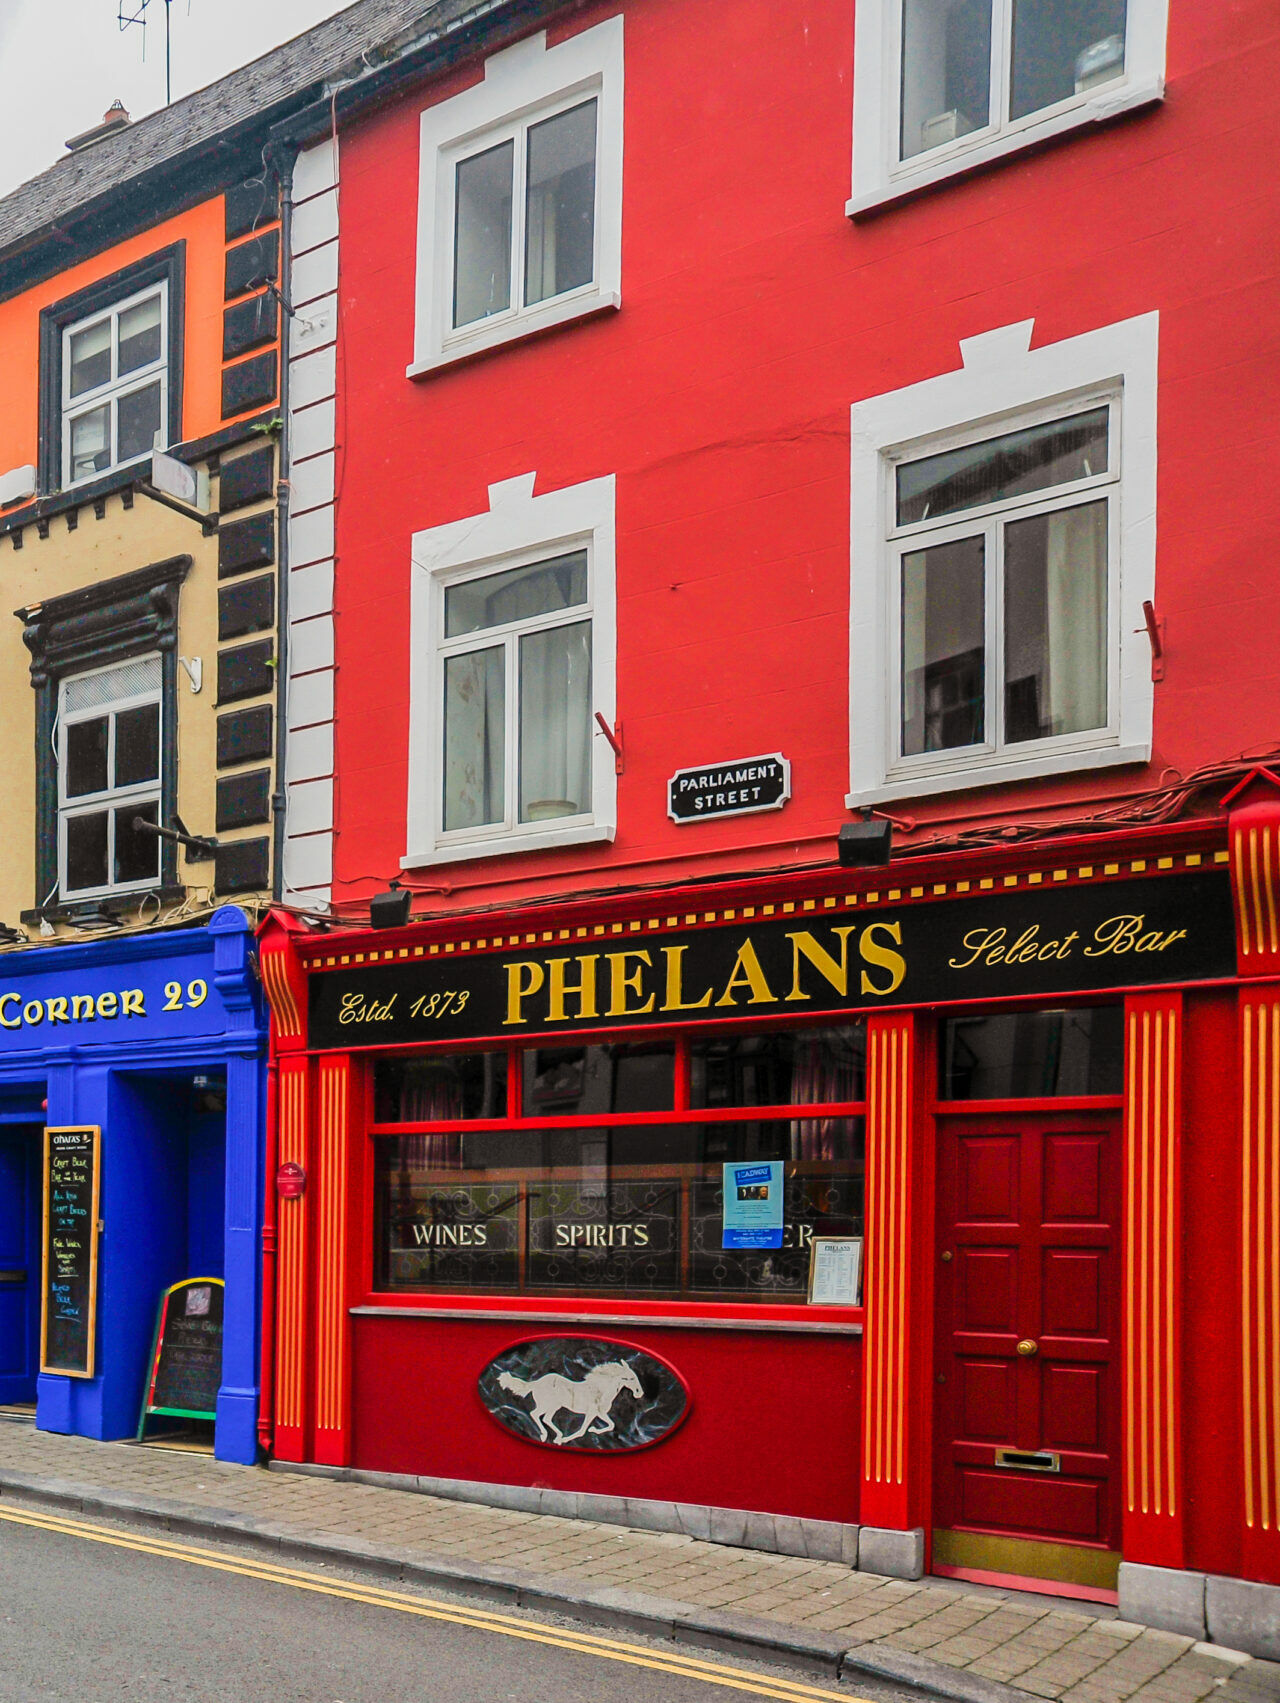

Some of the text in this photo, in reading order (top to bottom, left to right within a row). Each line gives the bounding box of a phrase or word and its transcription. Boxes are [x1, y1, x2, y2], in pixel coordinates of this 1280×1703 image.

[680, 764, 776, 792] PARLIAMENT
[694, 787, 760, 809] STREET
[948, 914, 1188, 969] Select Bar
[502, 921, 907, 1026] PHELANS
[161, 978, 208, 1012] 29
[338, 990, 470, 1025] Estd. 1873
[413, 1224, 487, 1246] WINES
[556, 1224, 650, 1246] SPIRITS
